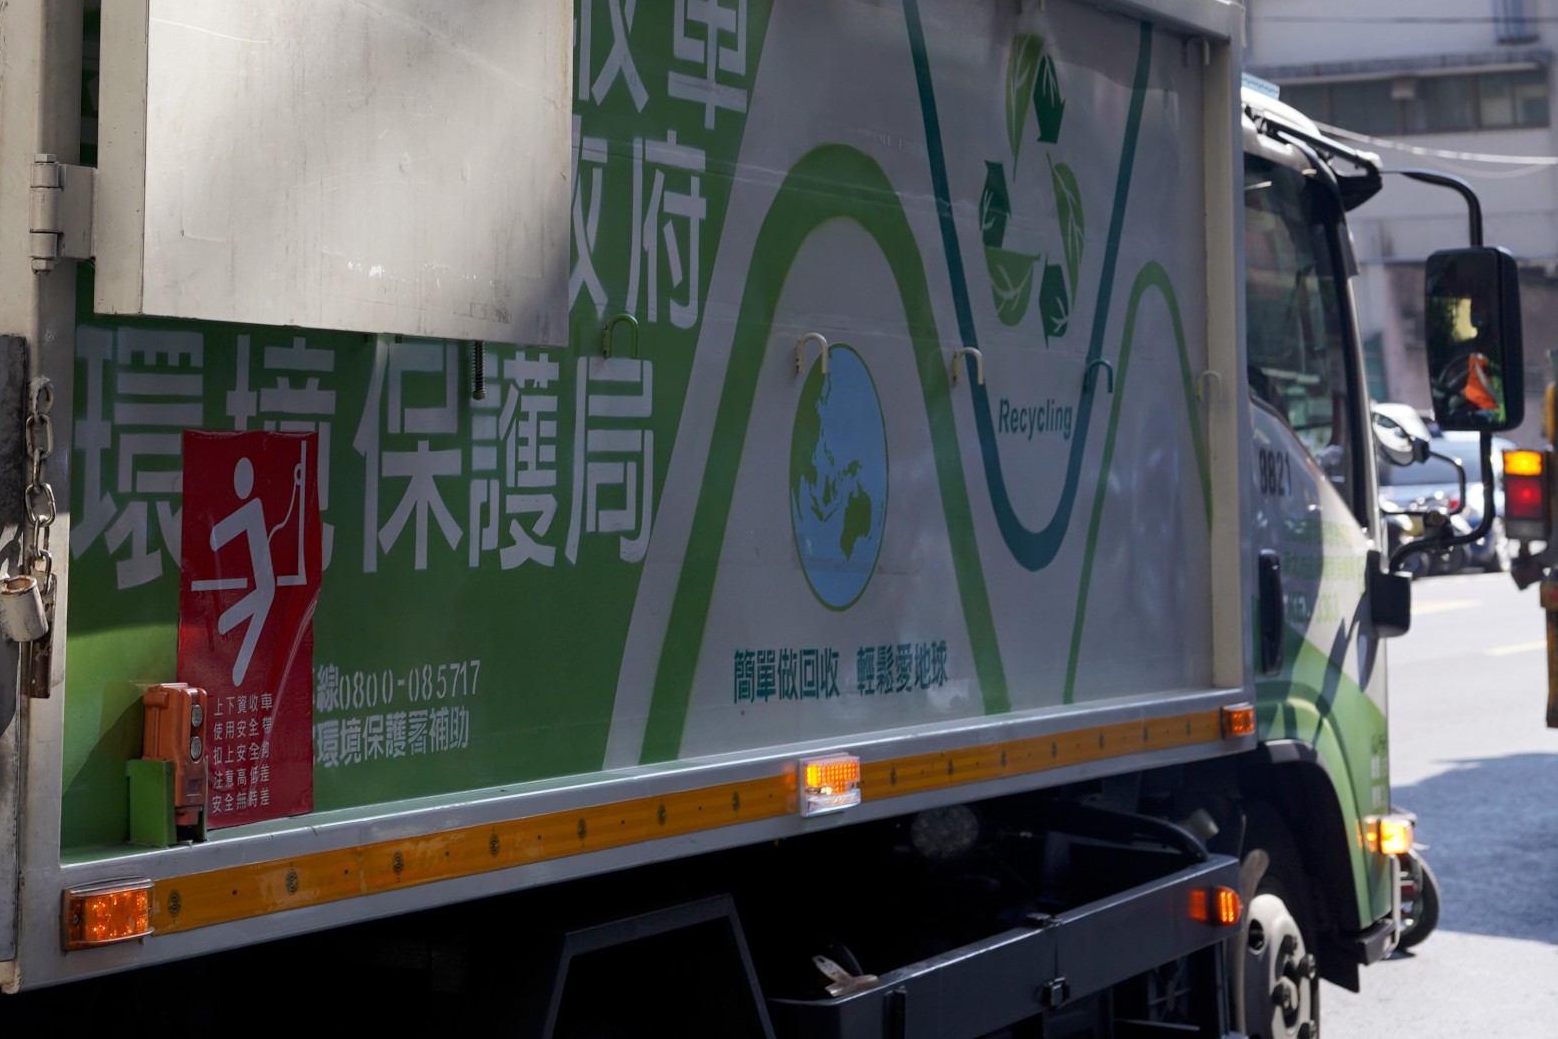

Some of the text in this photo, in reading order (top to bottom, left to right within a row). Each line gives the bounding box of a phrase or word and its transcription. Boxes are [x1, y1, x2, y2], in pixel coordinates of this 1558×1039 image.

[998, 398, 1074, 441] Recycling
[1259, 447, 1292, 497] 8821
[313, 660, 480, 712] 線0800-085717
[734, 639, 948, 704] 簡單做回收 輕鬆愛地球
[214, 693, 273, 716] 上下資收車
[213, 716, 273, 741] 使用安全帶
[313, 706, 469, 768] 環境保護署補助
[212, 765, 270, 790] 注意高低差
[212, 789, 270, 814] 安全無時差
